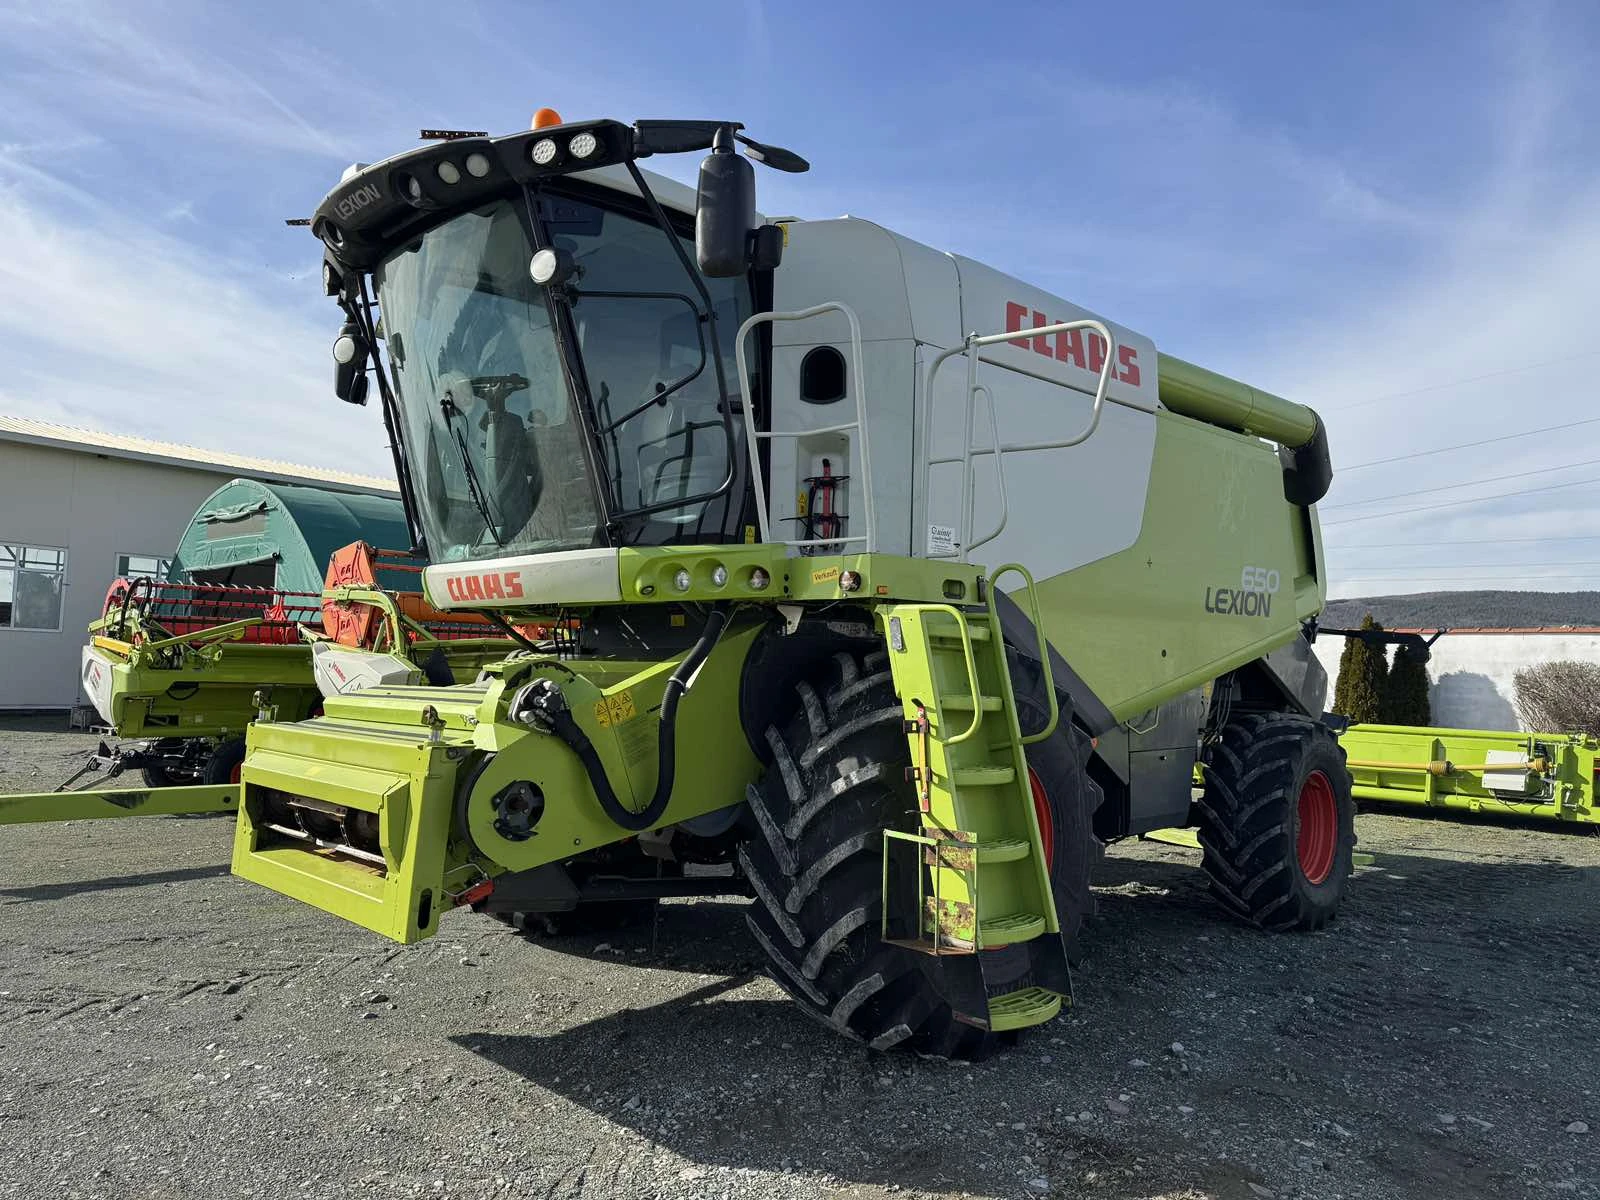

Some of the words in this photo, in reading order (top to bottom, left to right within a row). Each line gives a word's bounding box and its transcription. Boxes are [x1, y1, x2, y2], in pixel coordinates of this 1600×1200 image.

[334, 183, 382, 221] LEXION
[1006, 301, 1141, 388] CLAAS
[447, 571, 525, 602] CLAAS
[1242, 565, 1280, 593] 650
[1205, 586, 1272, 618] LEXION
